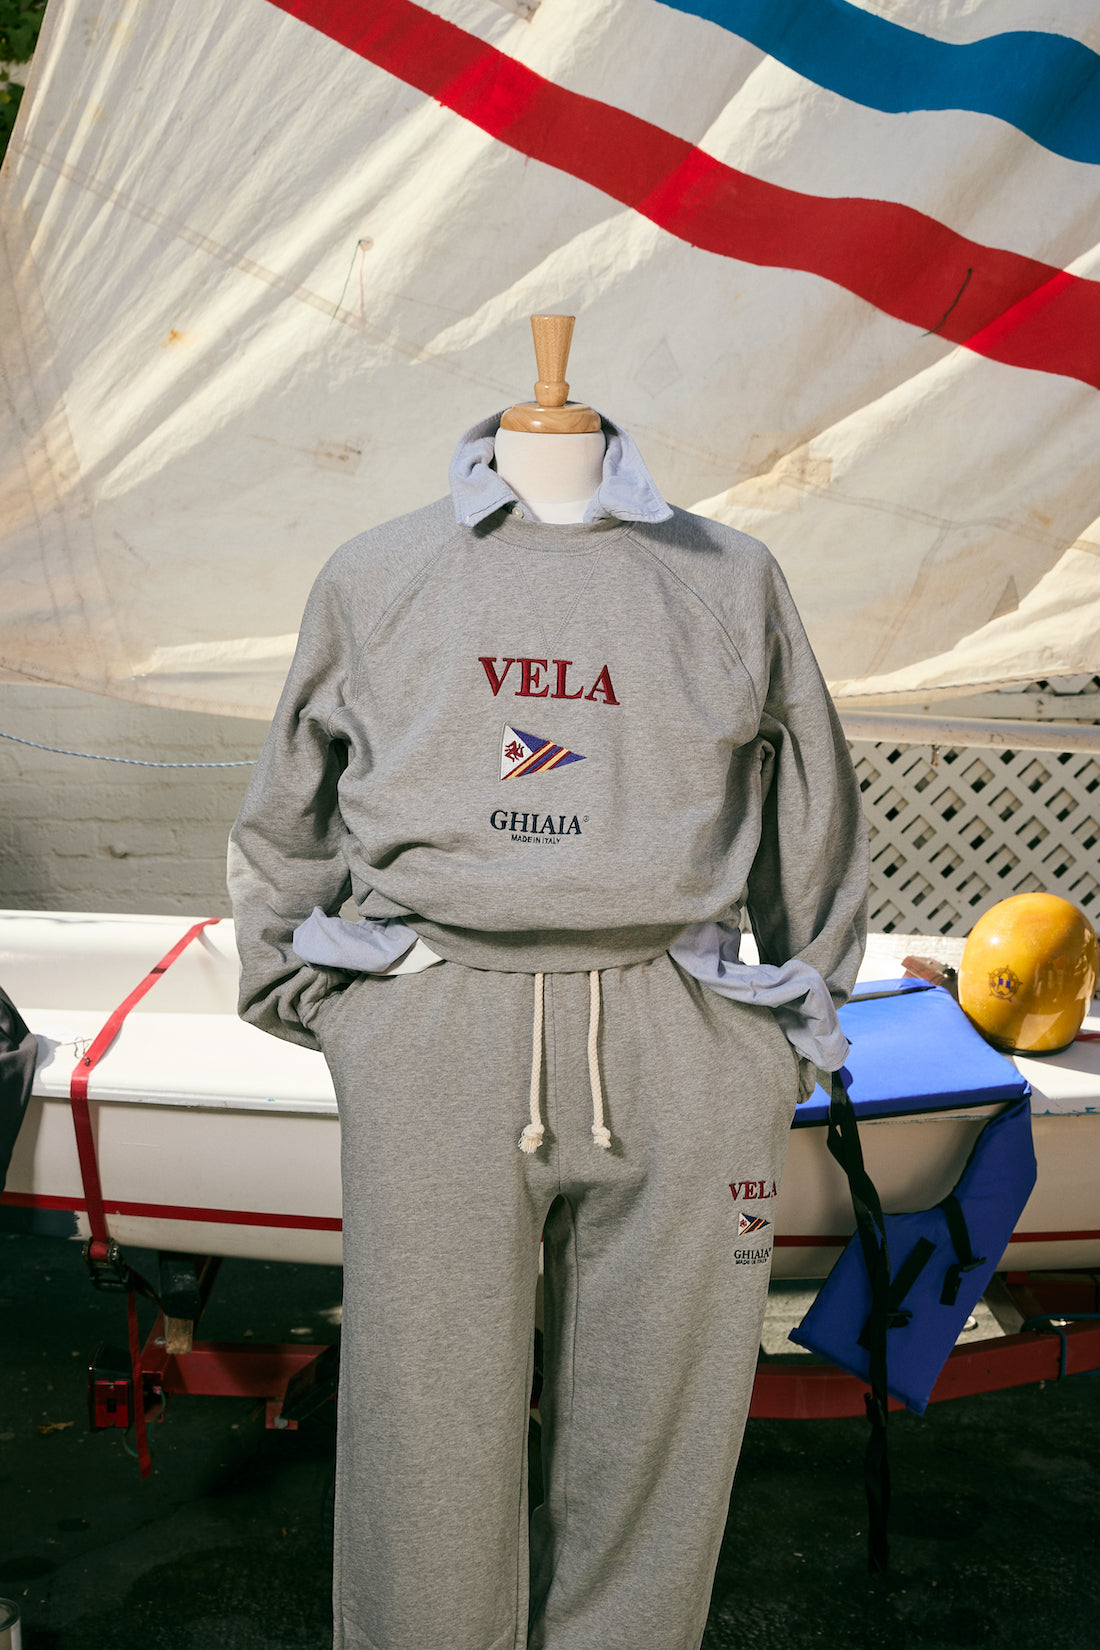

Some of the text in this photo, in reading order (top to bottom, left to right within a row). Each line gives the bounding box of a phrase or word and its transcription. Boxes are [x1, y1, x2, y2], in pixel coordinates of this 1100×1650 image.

[478, 657, 620, 705] VELA
[511, 834, 561, 845] MADE IN ITALY
[729, 1180, 777, 1201] VELA
